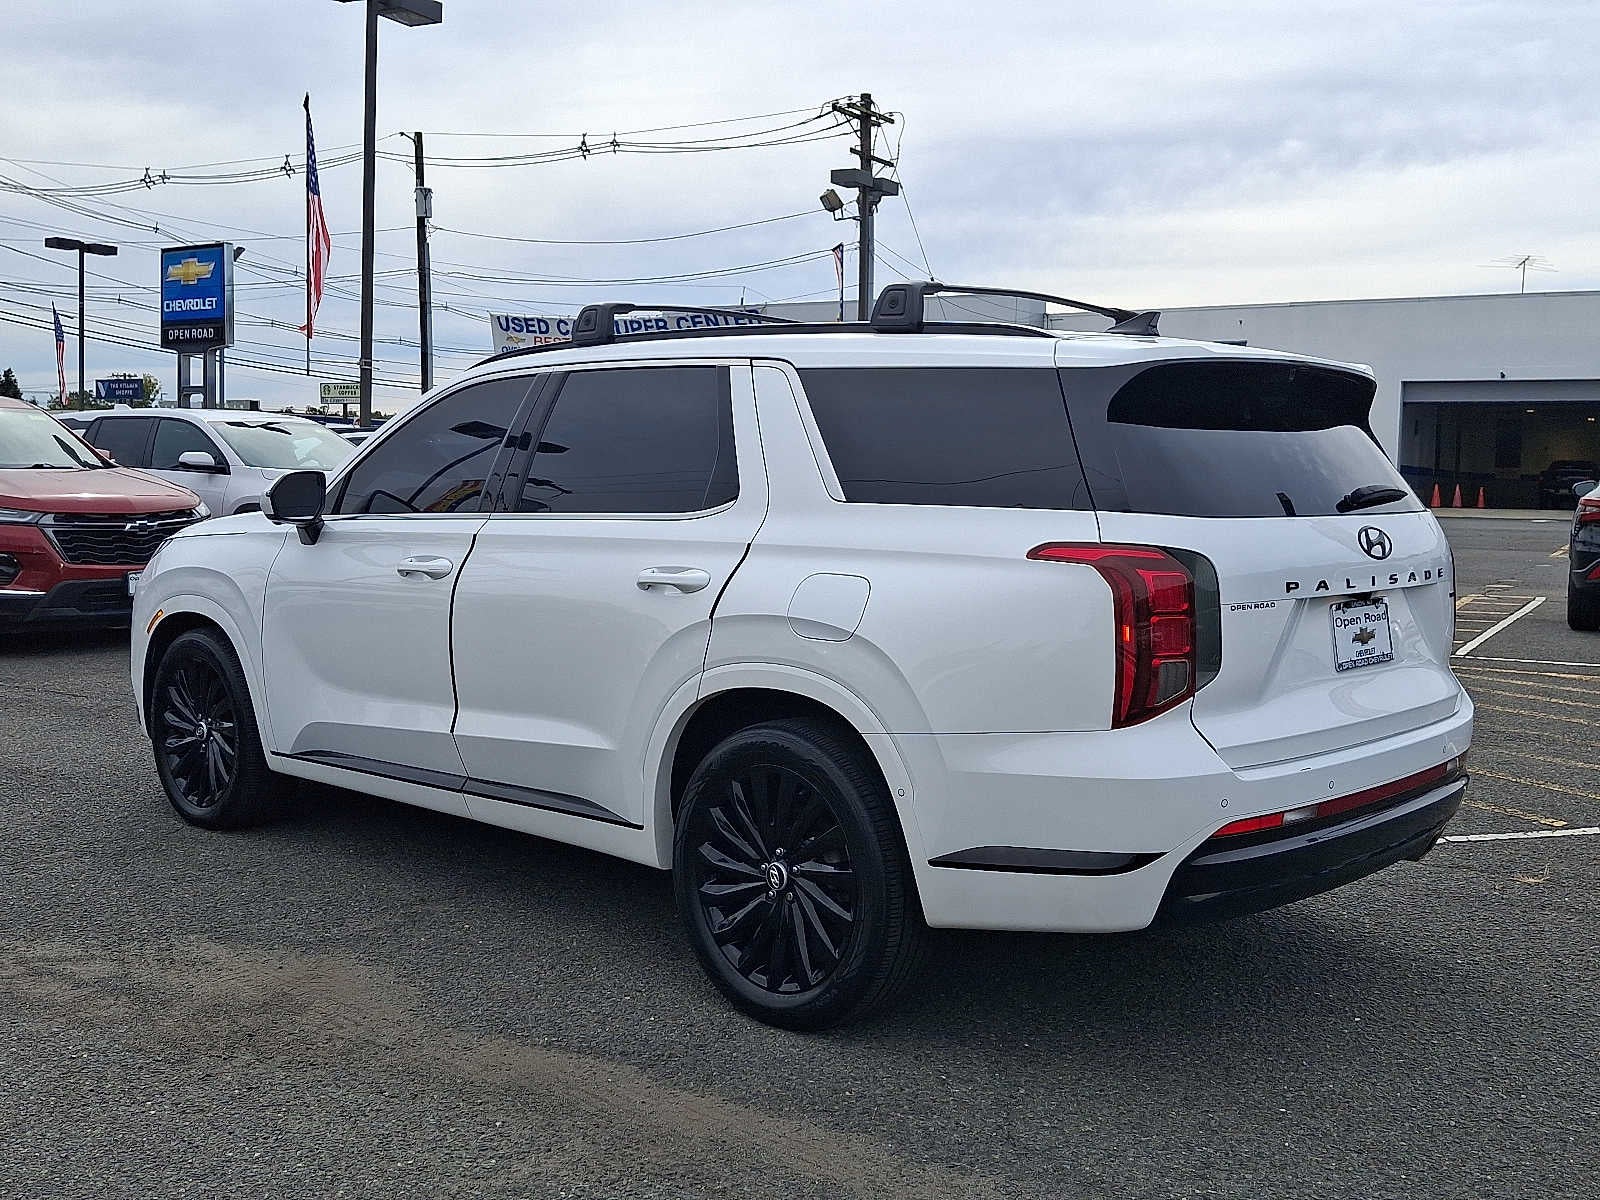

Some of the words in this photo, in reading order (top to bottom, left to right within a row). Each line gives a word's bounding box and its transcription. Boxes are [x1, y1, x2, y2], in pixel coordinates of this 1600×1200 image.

[163, 297, 218, 312] CHEVROLET
[496, 315, 550, 335] USED
[613, 318, 669, 334] UPER
[168, 329, 190, 340] OPEN
[191, 328, 214, 339] ROAD
[1285, 567, 1445, 594] PALISADE
[1230, 604, 1253, 612] OPEN
[1254, 602, 1276, 610] ROAD
[1335, 616, 1362, 630] Open
[1363, 610, 1387, 624] Road
